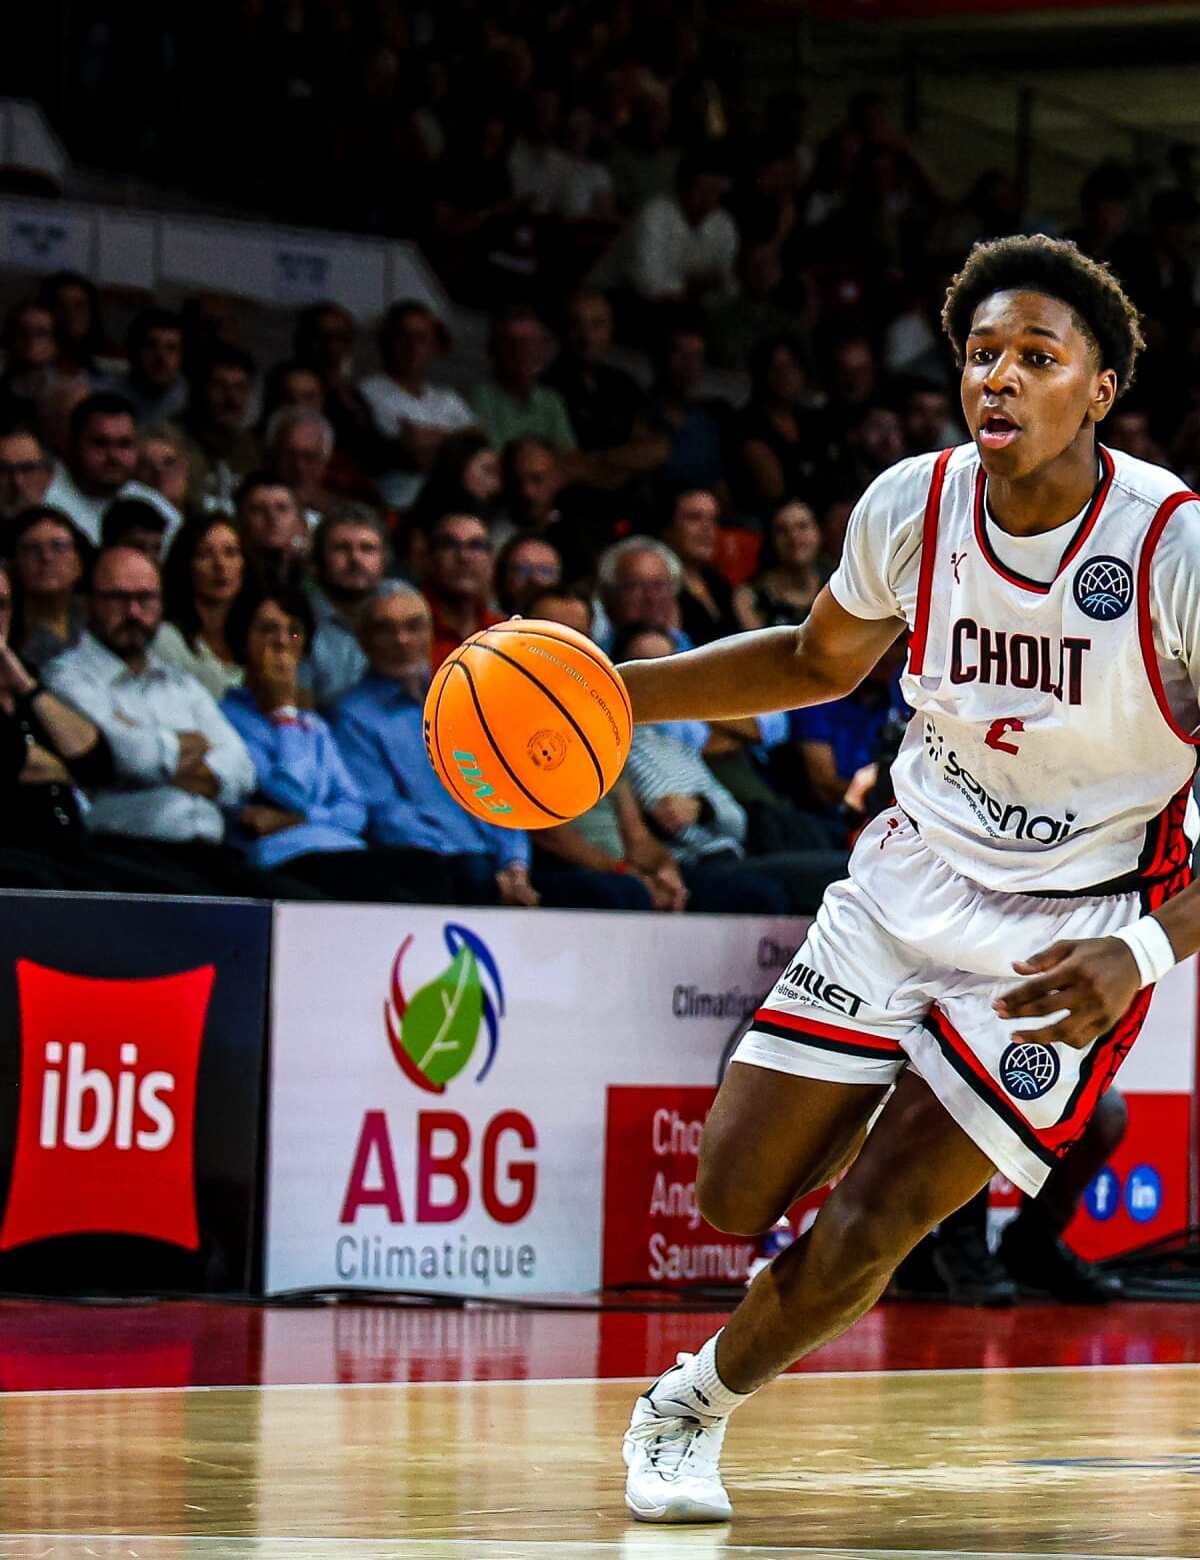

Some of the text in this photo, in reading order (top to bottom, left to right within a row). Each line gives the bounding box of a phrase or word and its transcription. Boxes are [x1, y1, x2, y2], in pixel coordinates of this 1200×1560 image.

[949, 617, 1091, 706] CHOLT
[784, 960, 872, 1018] MILLET
[40, 1042, 175, 1150] ibis
[653, 1108, 704, 1155] Cho
[339, 1109, 538, 1225] ABG
[650, 1172, 700, 1230] Ang
[335, 1235, 536, 1288] Climatique
[649, 1232, 754, 1280] Saumur
